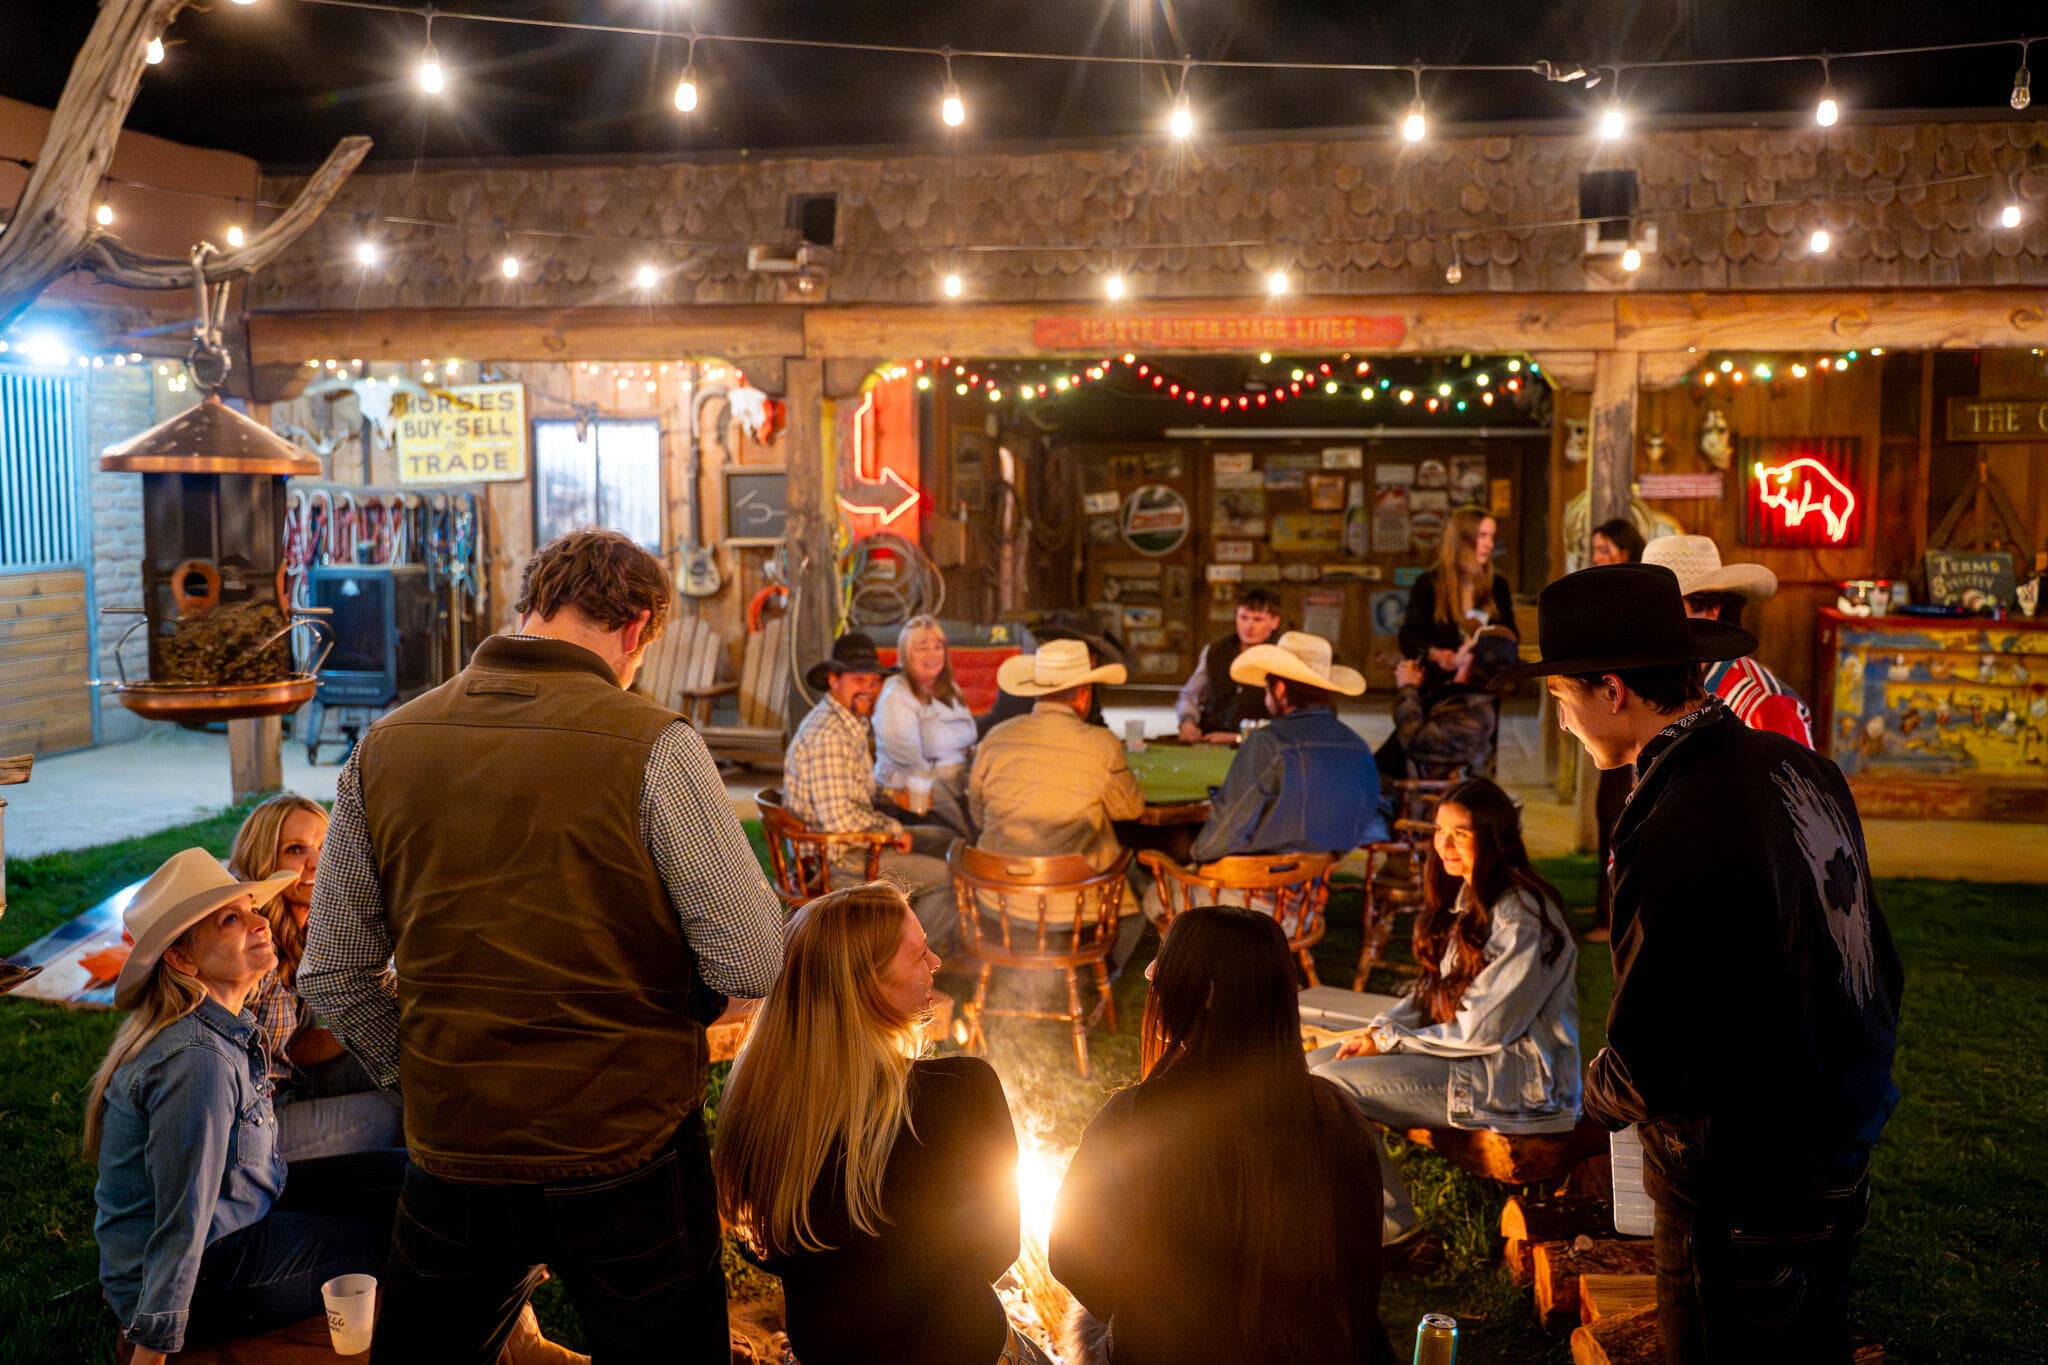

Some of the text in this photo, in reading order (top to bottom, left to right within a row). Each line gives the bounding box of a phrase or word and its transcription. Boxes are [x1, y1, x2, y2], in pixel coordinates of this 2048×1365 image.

[1161, 319, 1218, 340] RIVER
[1226, 319, 1287, 340] STAGE
[1296, 318, 1357, 340] LINES
[1966, 403, 2020, 432] THE
[408, 452, 509, 474] TRADE
